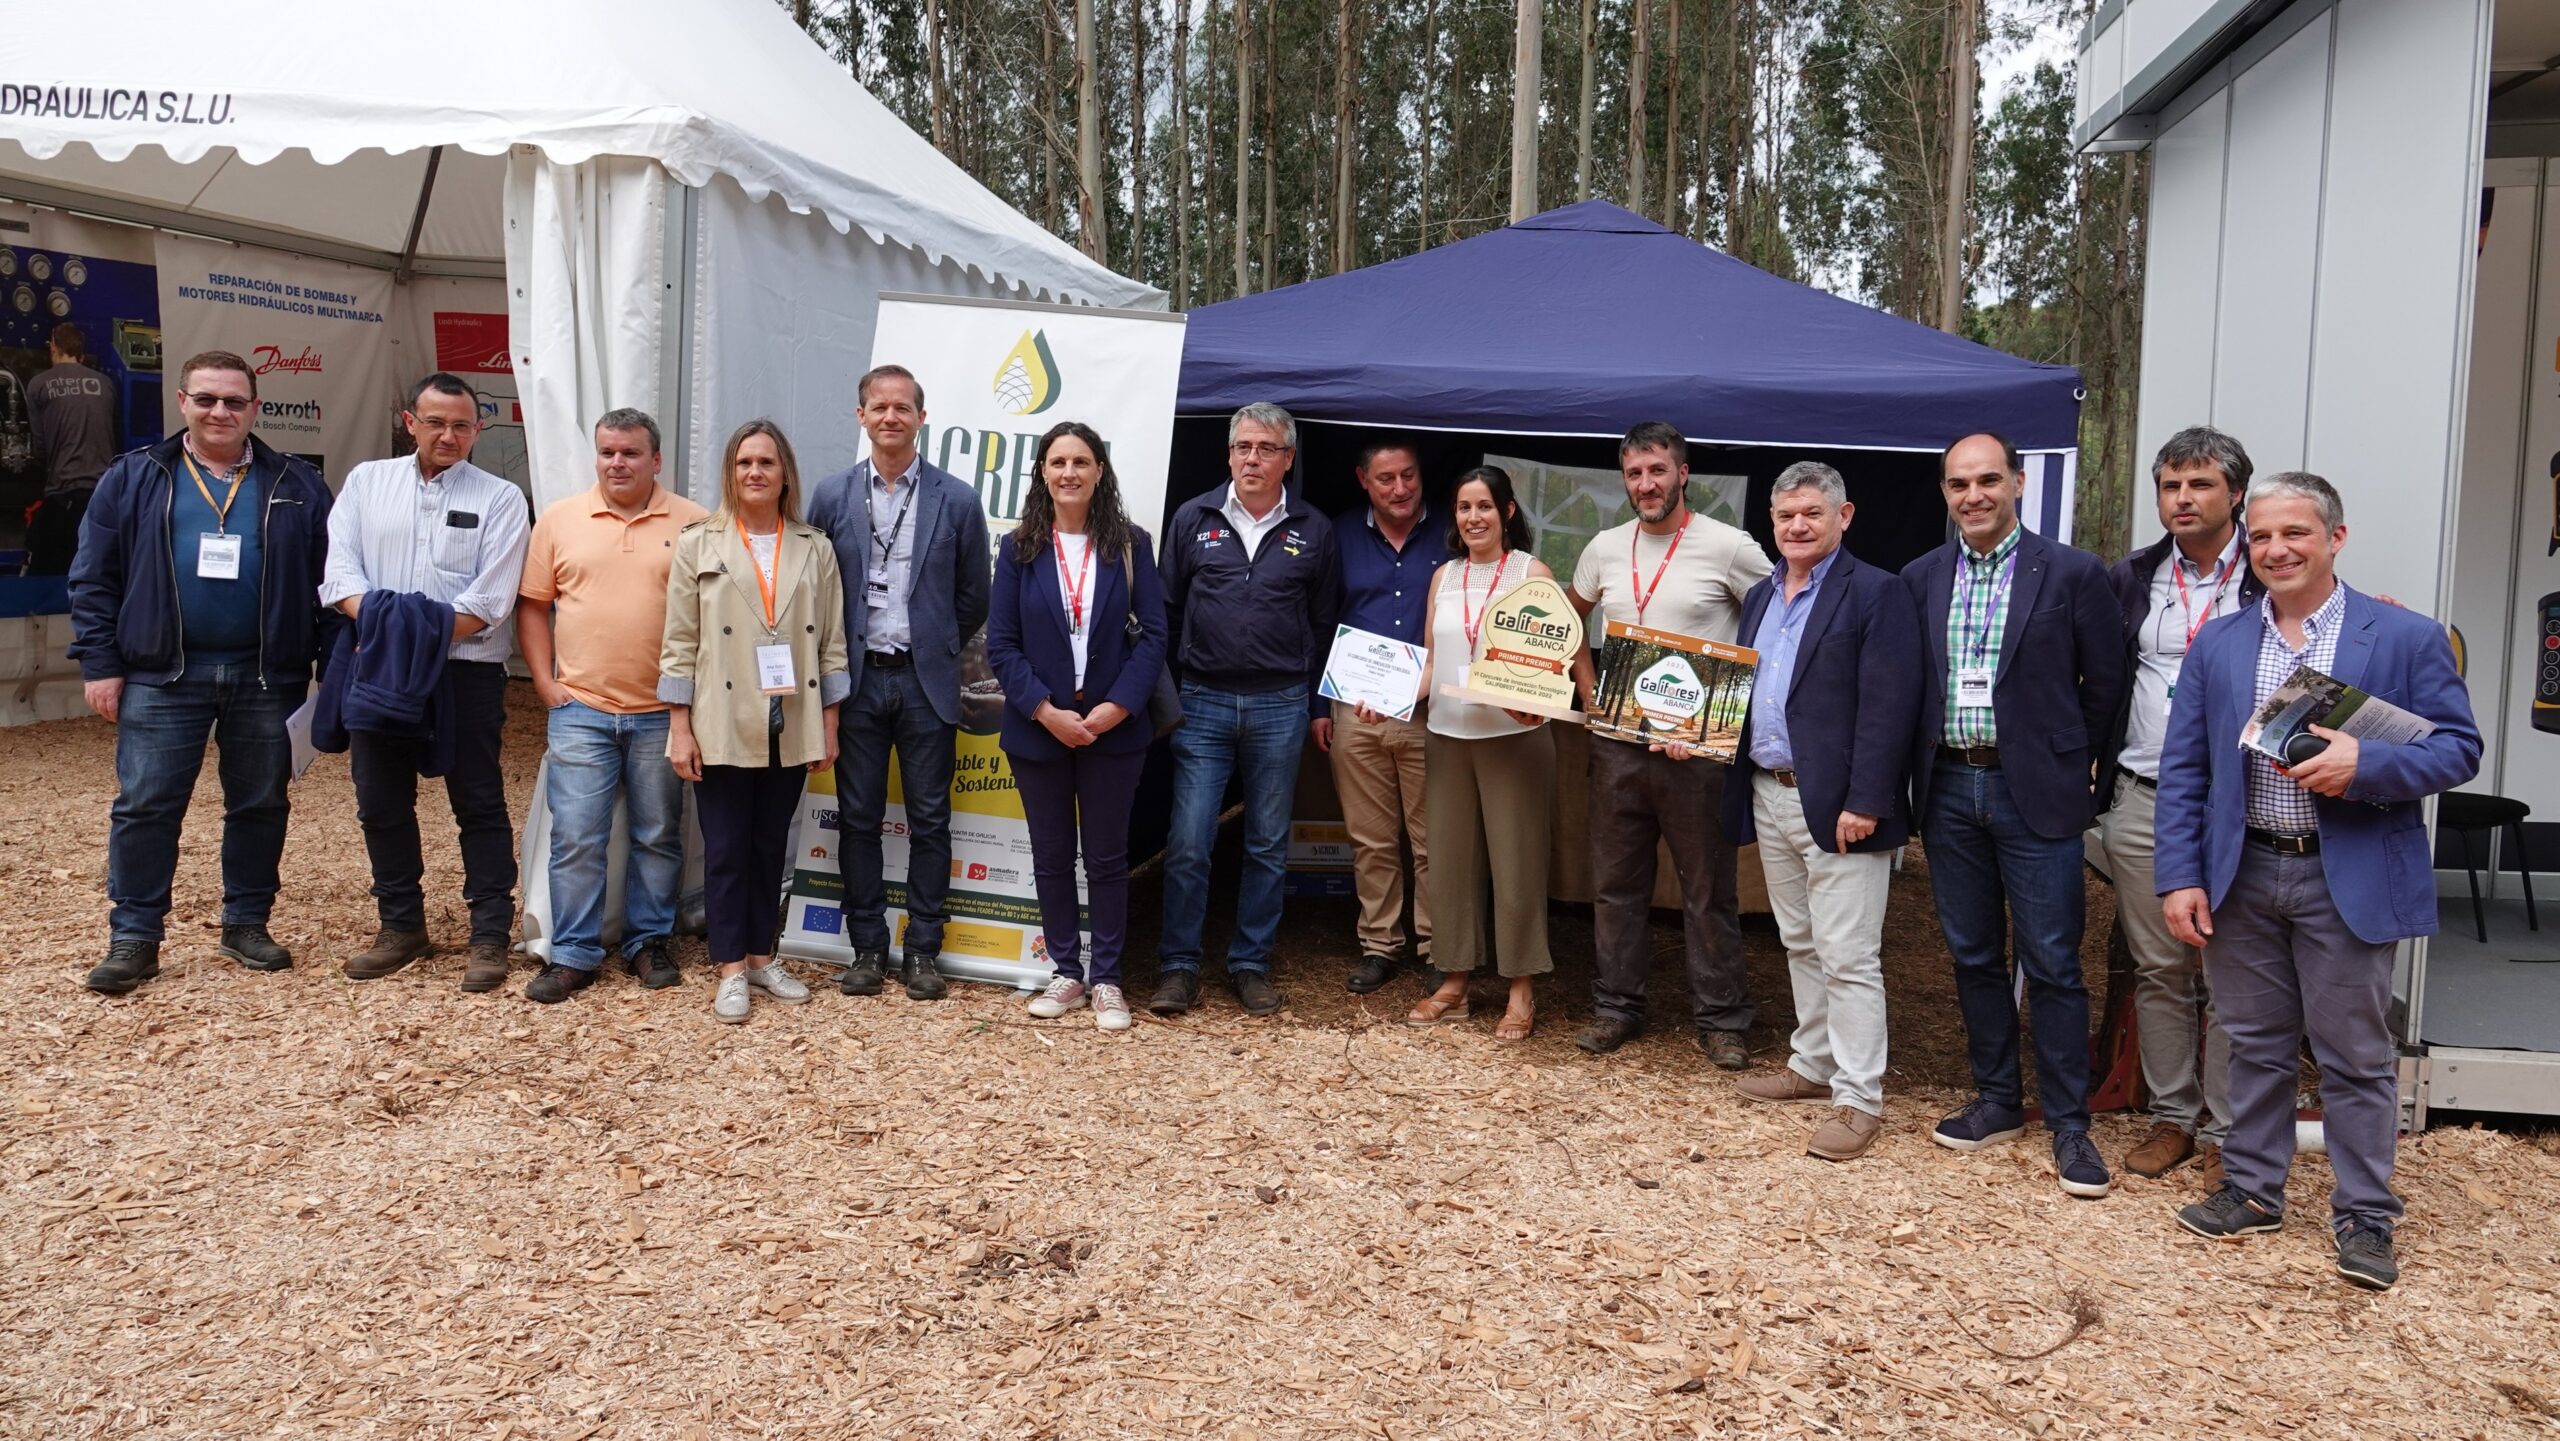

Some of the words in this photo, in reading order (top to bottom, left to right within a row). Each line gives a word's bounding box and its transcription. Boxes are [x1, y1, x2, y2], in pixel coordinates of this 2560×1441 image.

[155, 91, 235, 125] S.L.U.
[208, 273, 282, 294] REPARACIÓN
[286, 285, 301, 298] DE
[303, 288, 348, 305] BOMBAS
[350, 296, 357, 306] Y
[178, 286, 235, 304] MOTORES
[238, 294, 314, 315] HIDRÁULICOS
[317, 306, 384, 323] MULTIMARCA
[253, 345, 322, 375] Danfoss
[478, 350, 513, 369] Lin
[260, 400, 320, 420] exroth
[263, 420, 287, 431] Bosch
[288, 422, 321, 434] Company
[1528, 590, 1552, 599] 2022
[1494, 609, 1571, 639] Galiforest
[1524, 637, 1565, 652] ABANCA
[1497, 652, 1524, 663] PRIMER
[1525, 658, 1553, 669] PREMIO
[1480, 672, 1502, 682] Concurso
[1485, 680, 1516, 690] GALIFOREST
[1516, 687, 1537, 696] ABANCA
[1640, 676, 1700, 701] Galiforest
[1662, 698, 1695, 712] ABANCA
[1664, 714, 1685, 724] PREMIO
[954, 754, 986, 771] able
[990, 756, 1000, 774] y
[955, 775, 1018, 793] Sosteni
[812, 809, 838, 822] USC
[881, 820, 912, 836] CSI
[989, 867, 1019, 875] asmadera
[808, 878, 828, 887] Proyecto
[977, 906, 994, 914] FEADER
[999, 902, 1020, 911] Programa
[1021, 904, 1040, 913] Nacional
